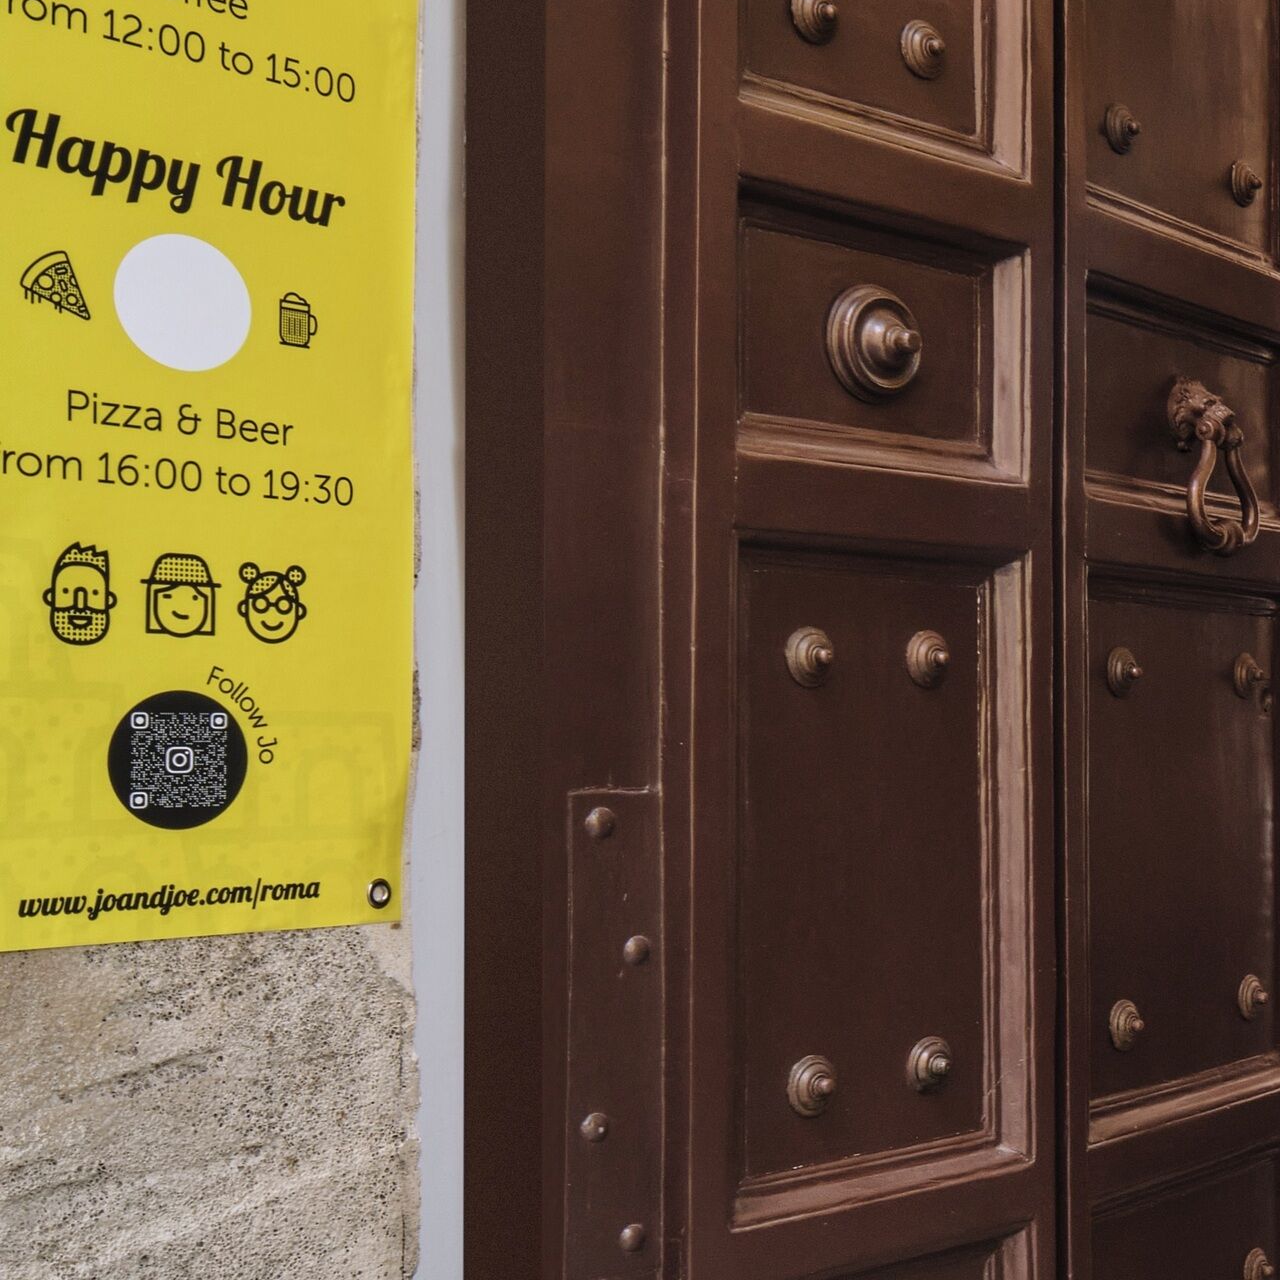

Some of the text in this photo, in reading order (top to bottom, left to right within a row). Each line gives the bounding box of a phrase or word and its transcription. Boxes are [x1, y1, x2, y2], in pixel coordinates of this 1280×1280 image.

[104, 10, 205, 62] 12:00
[219, 42, 253, 75] to
[267, 54, 355, 102] 15:00
[6, 109, 345, 226] Happy Hour
[68, 390, 293, 445] Pizza & Beer
[98, 453, 201, 491] 16:00
[216, 467, 250, 496] to
[264, 470, 353, 506] 19:30
[206, 665, 278, 764] Follow Jo
[19, 879, 320, 920] www.joandjoe.com/roma
